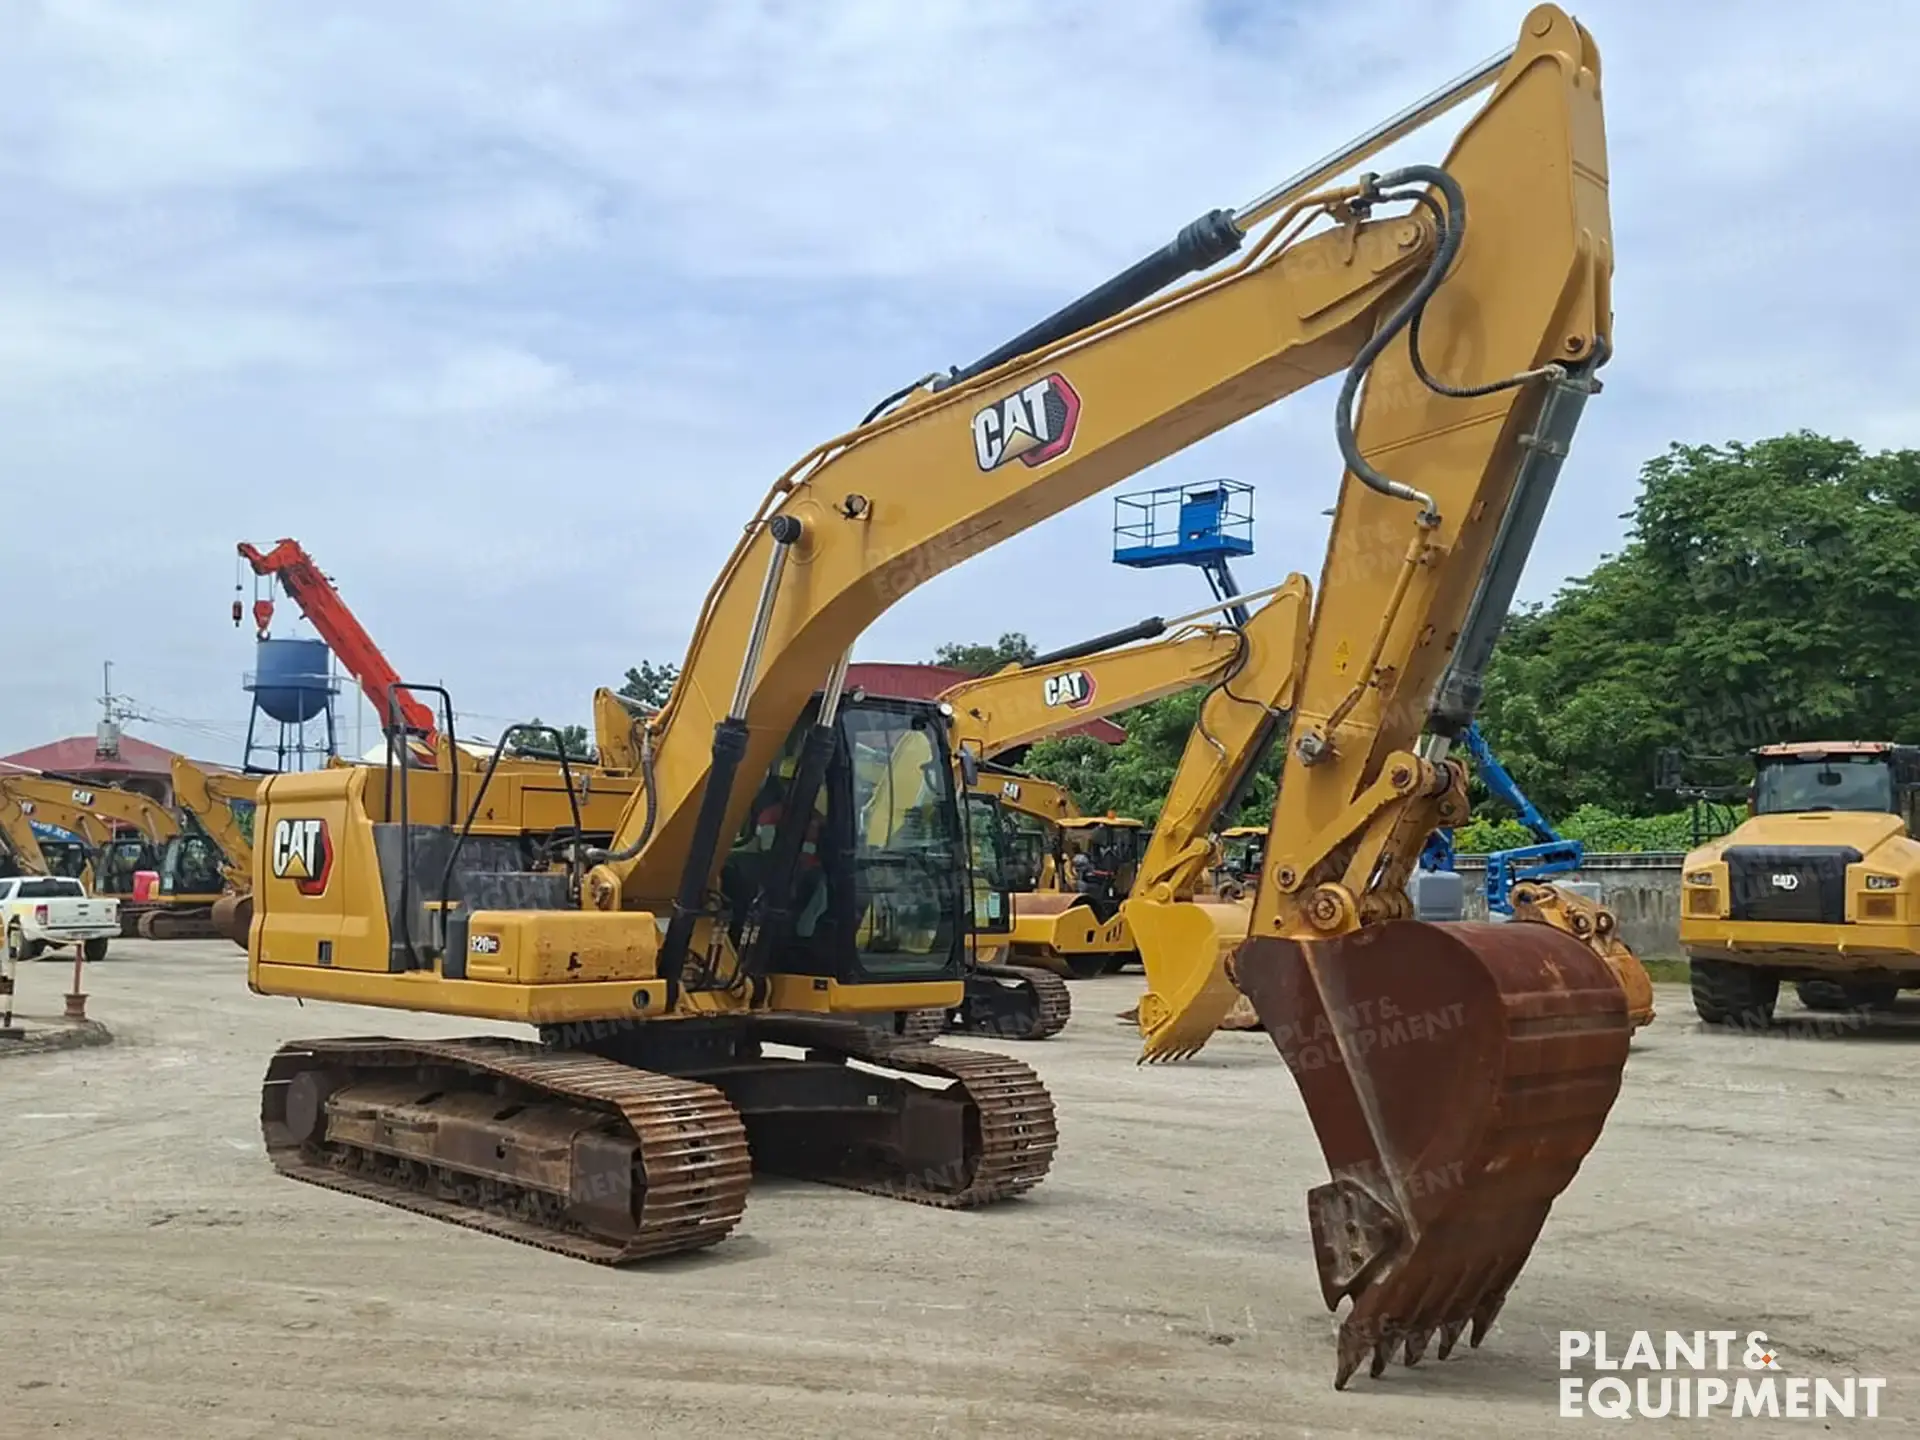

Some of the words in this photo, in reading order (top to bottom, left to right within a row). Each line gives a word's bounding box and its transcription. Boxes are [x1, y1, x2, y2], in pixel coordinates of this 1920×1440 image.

[974, 378, 1050, 470] CAT
[1044, 671, 1082, 706] CAT
[273, 819, 321, 878] CAT
